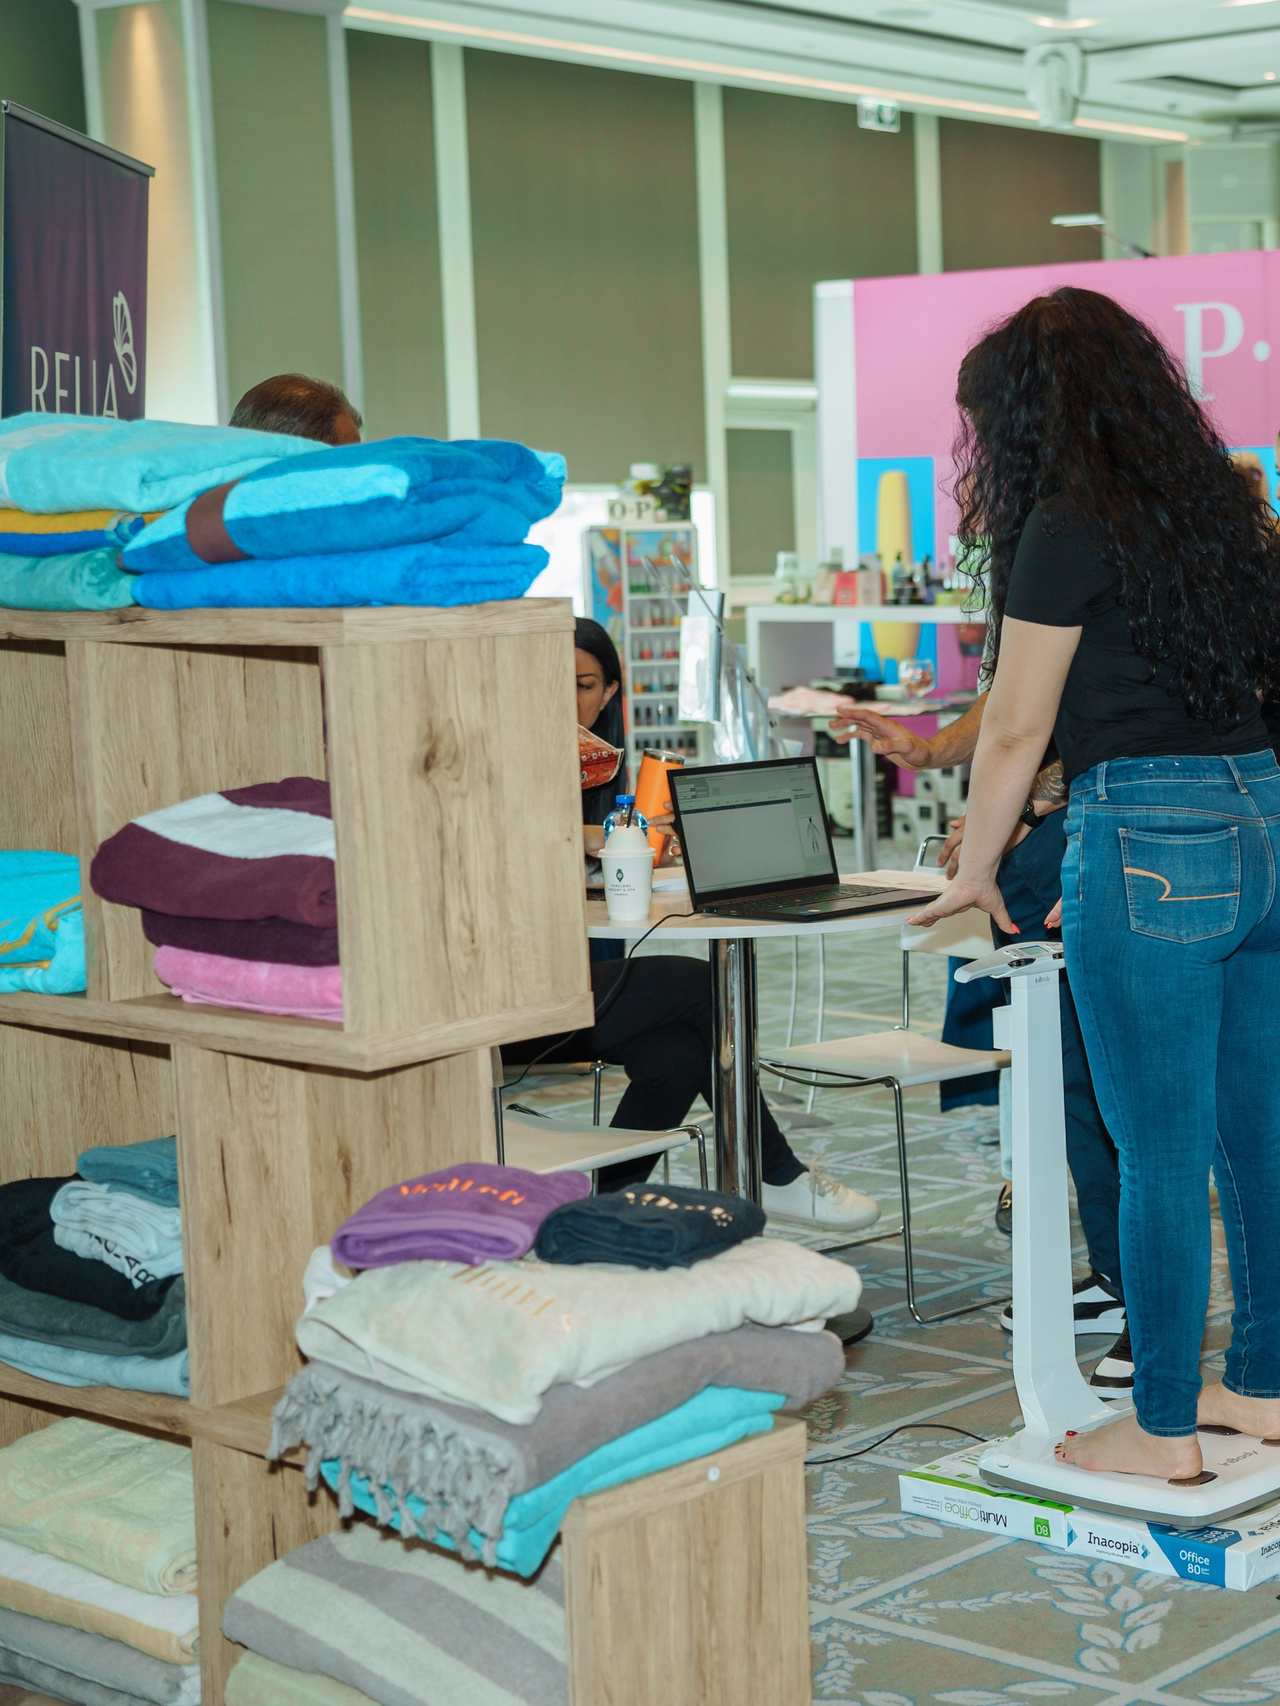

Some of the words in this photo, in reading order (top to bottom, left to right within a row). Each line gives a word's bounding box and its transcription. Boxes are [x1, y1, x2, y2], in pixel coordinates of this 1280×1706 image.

[944, 1502, 1008, 1528] MultiOffice
[1036, 1524, 1049, 1536] 80
[1087, 1531, 1140, 1555] Inacopia
[1179, 1550, 1210, 1566] Office
[1187, 1563, 1201, 1575] 80
